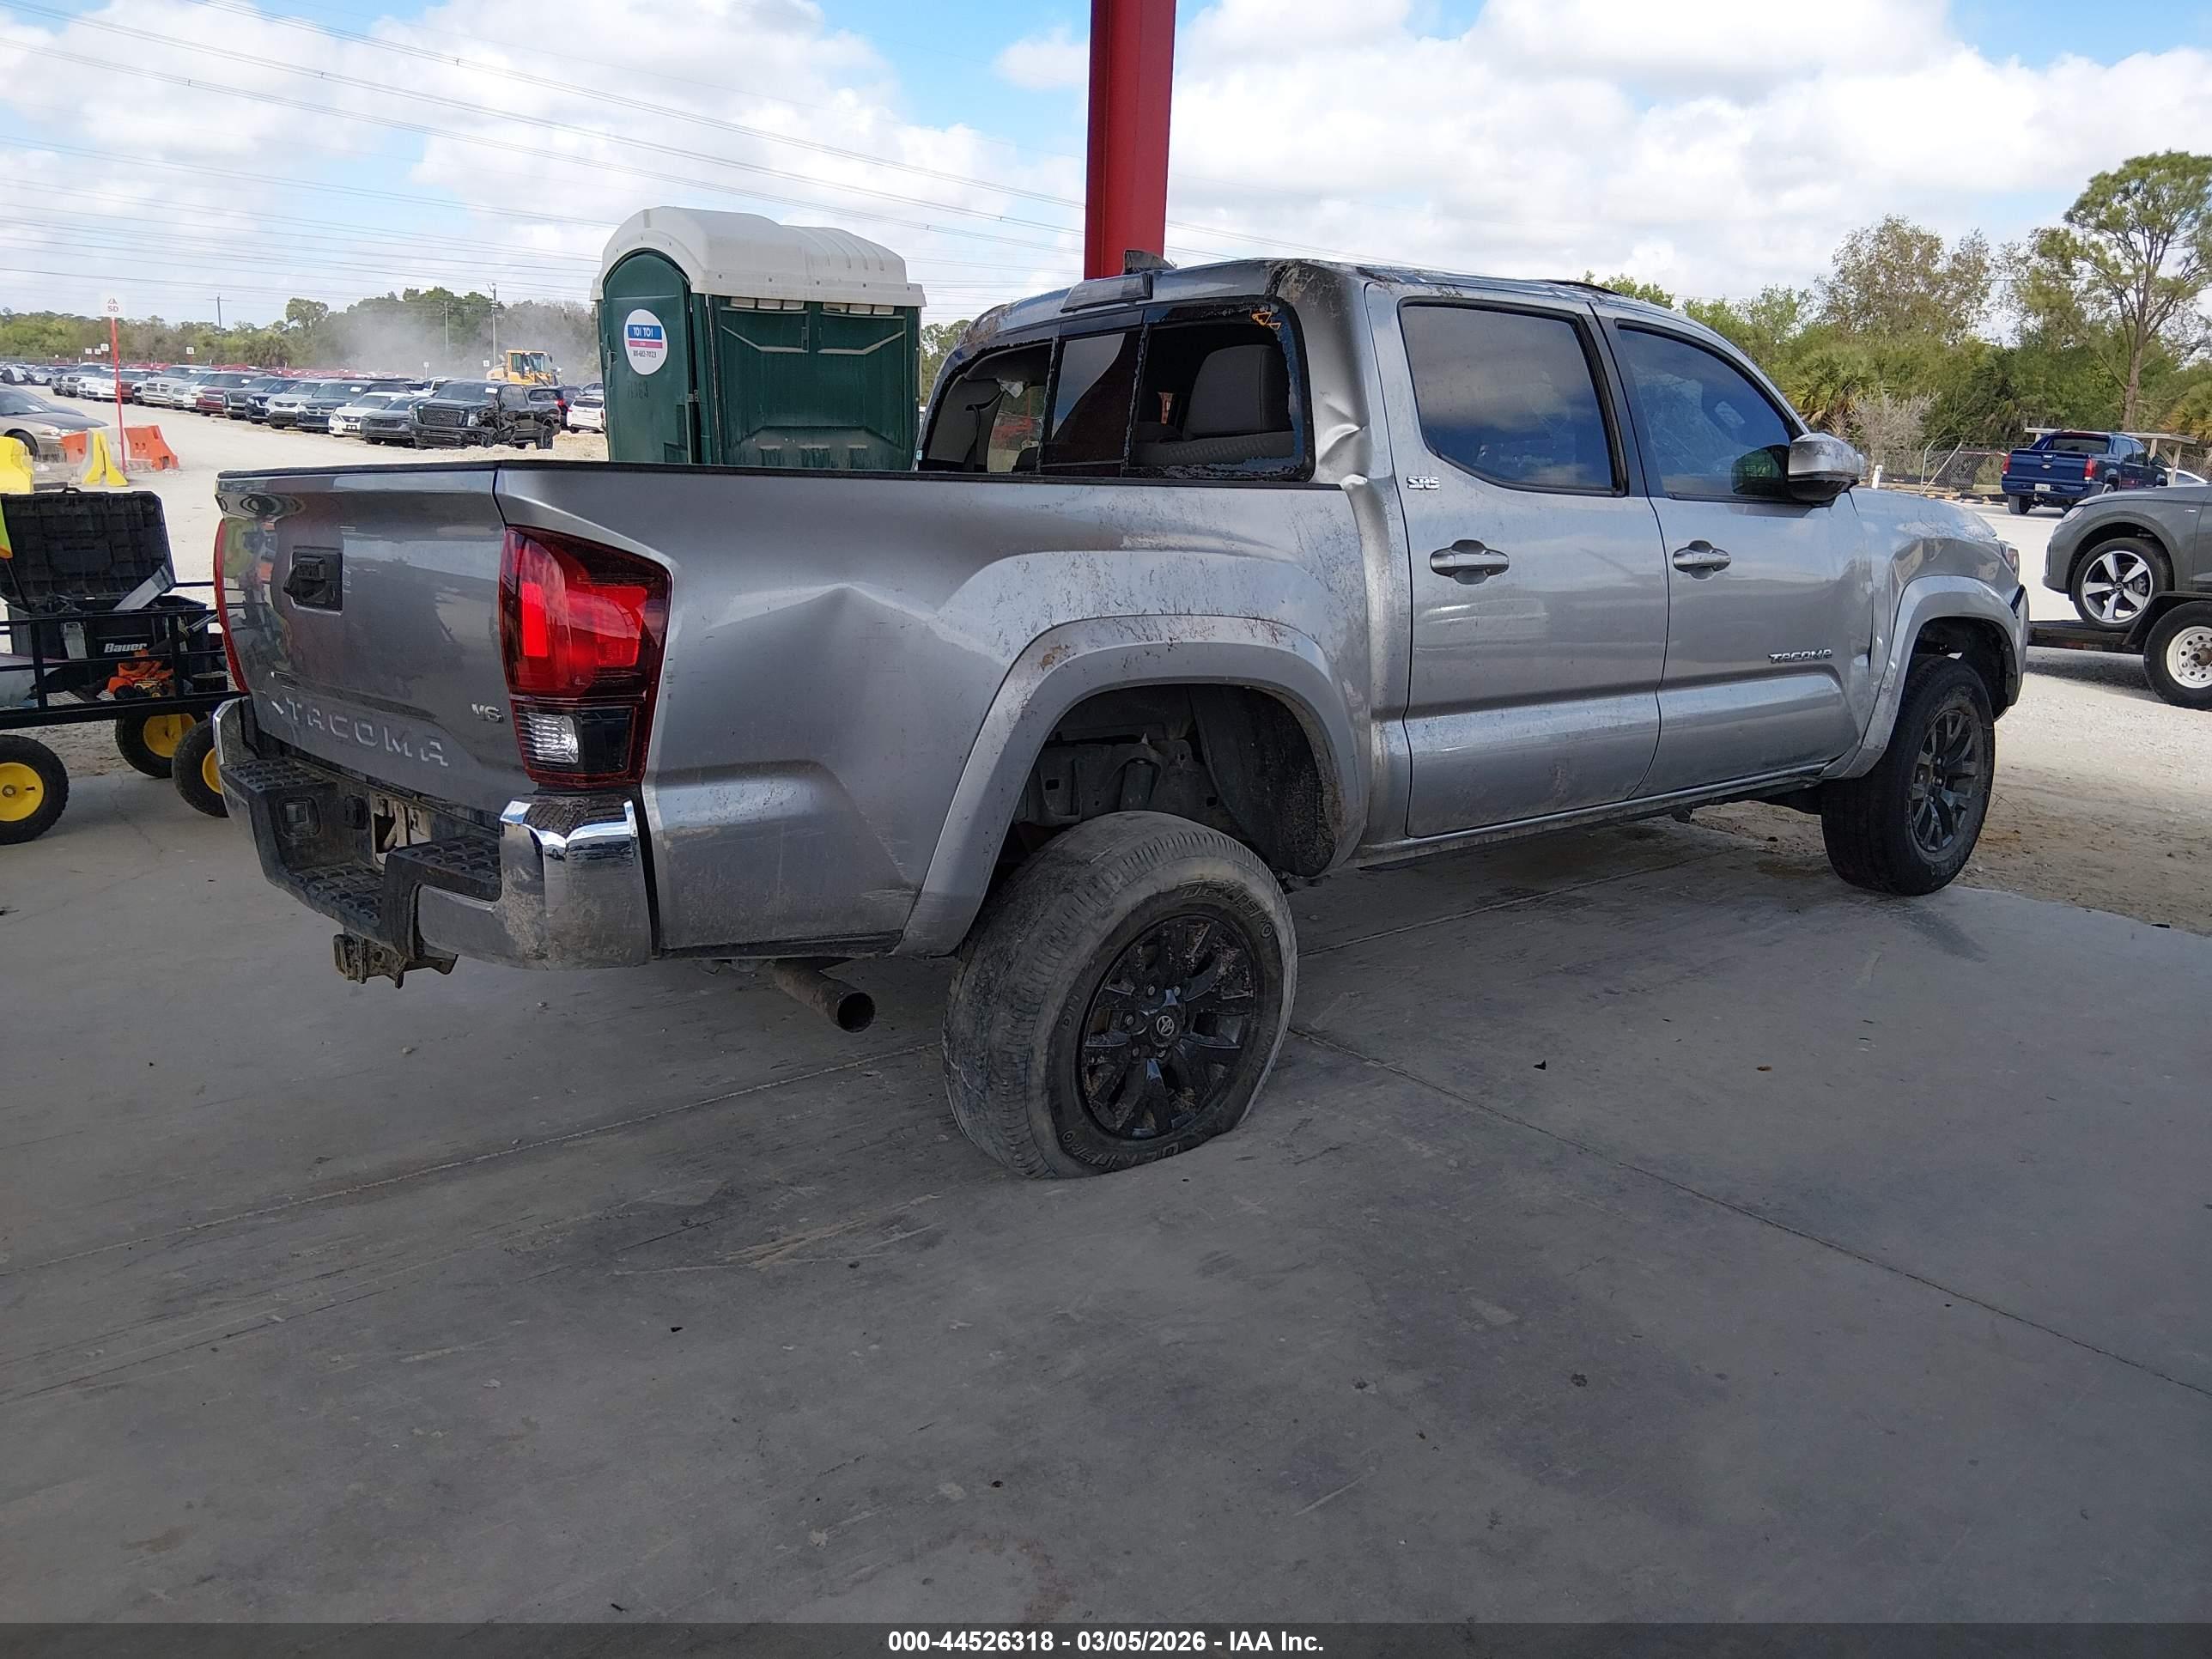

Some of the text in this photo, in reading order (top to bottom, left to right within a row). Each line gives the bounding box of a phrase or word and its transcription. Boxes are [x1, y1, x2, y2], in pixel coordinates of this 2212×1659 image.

[643, 327, 653, 337] TOI
[104, 643, 148, 653] Bauer
[1768, 648, 1833, 663] TACOMA
[471, 702, 505, 724] V6
[286, 696, 449, 768] TACOMA
